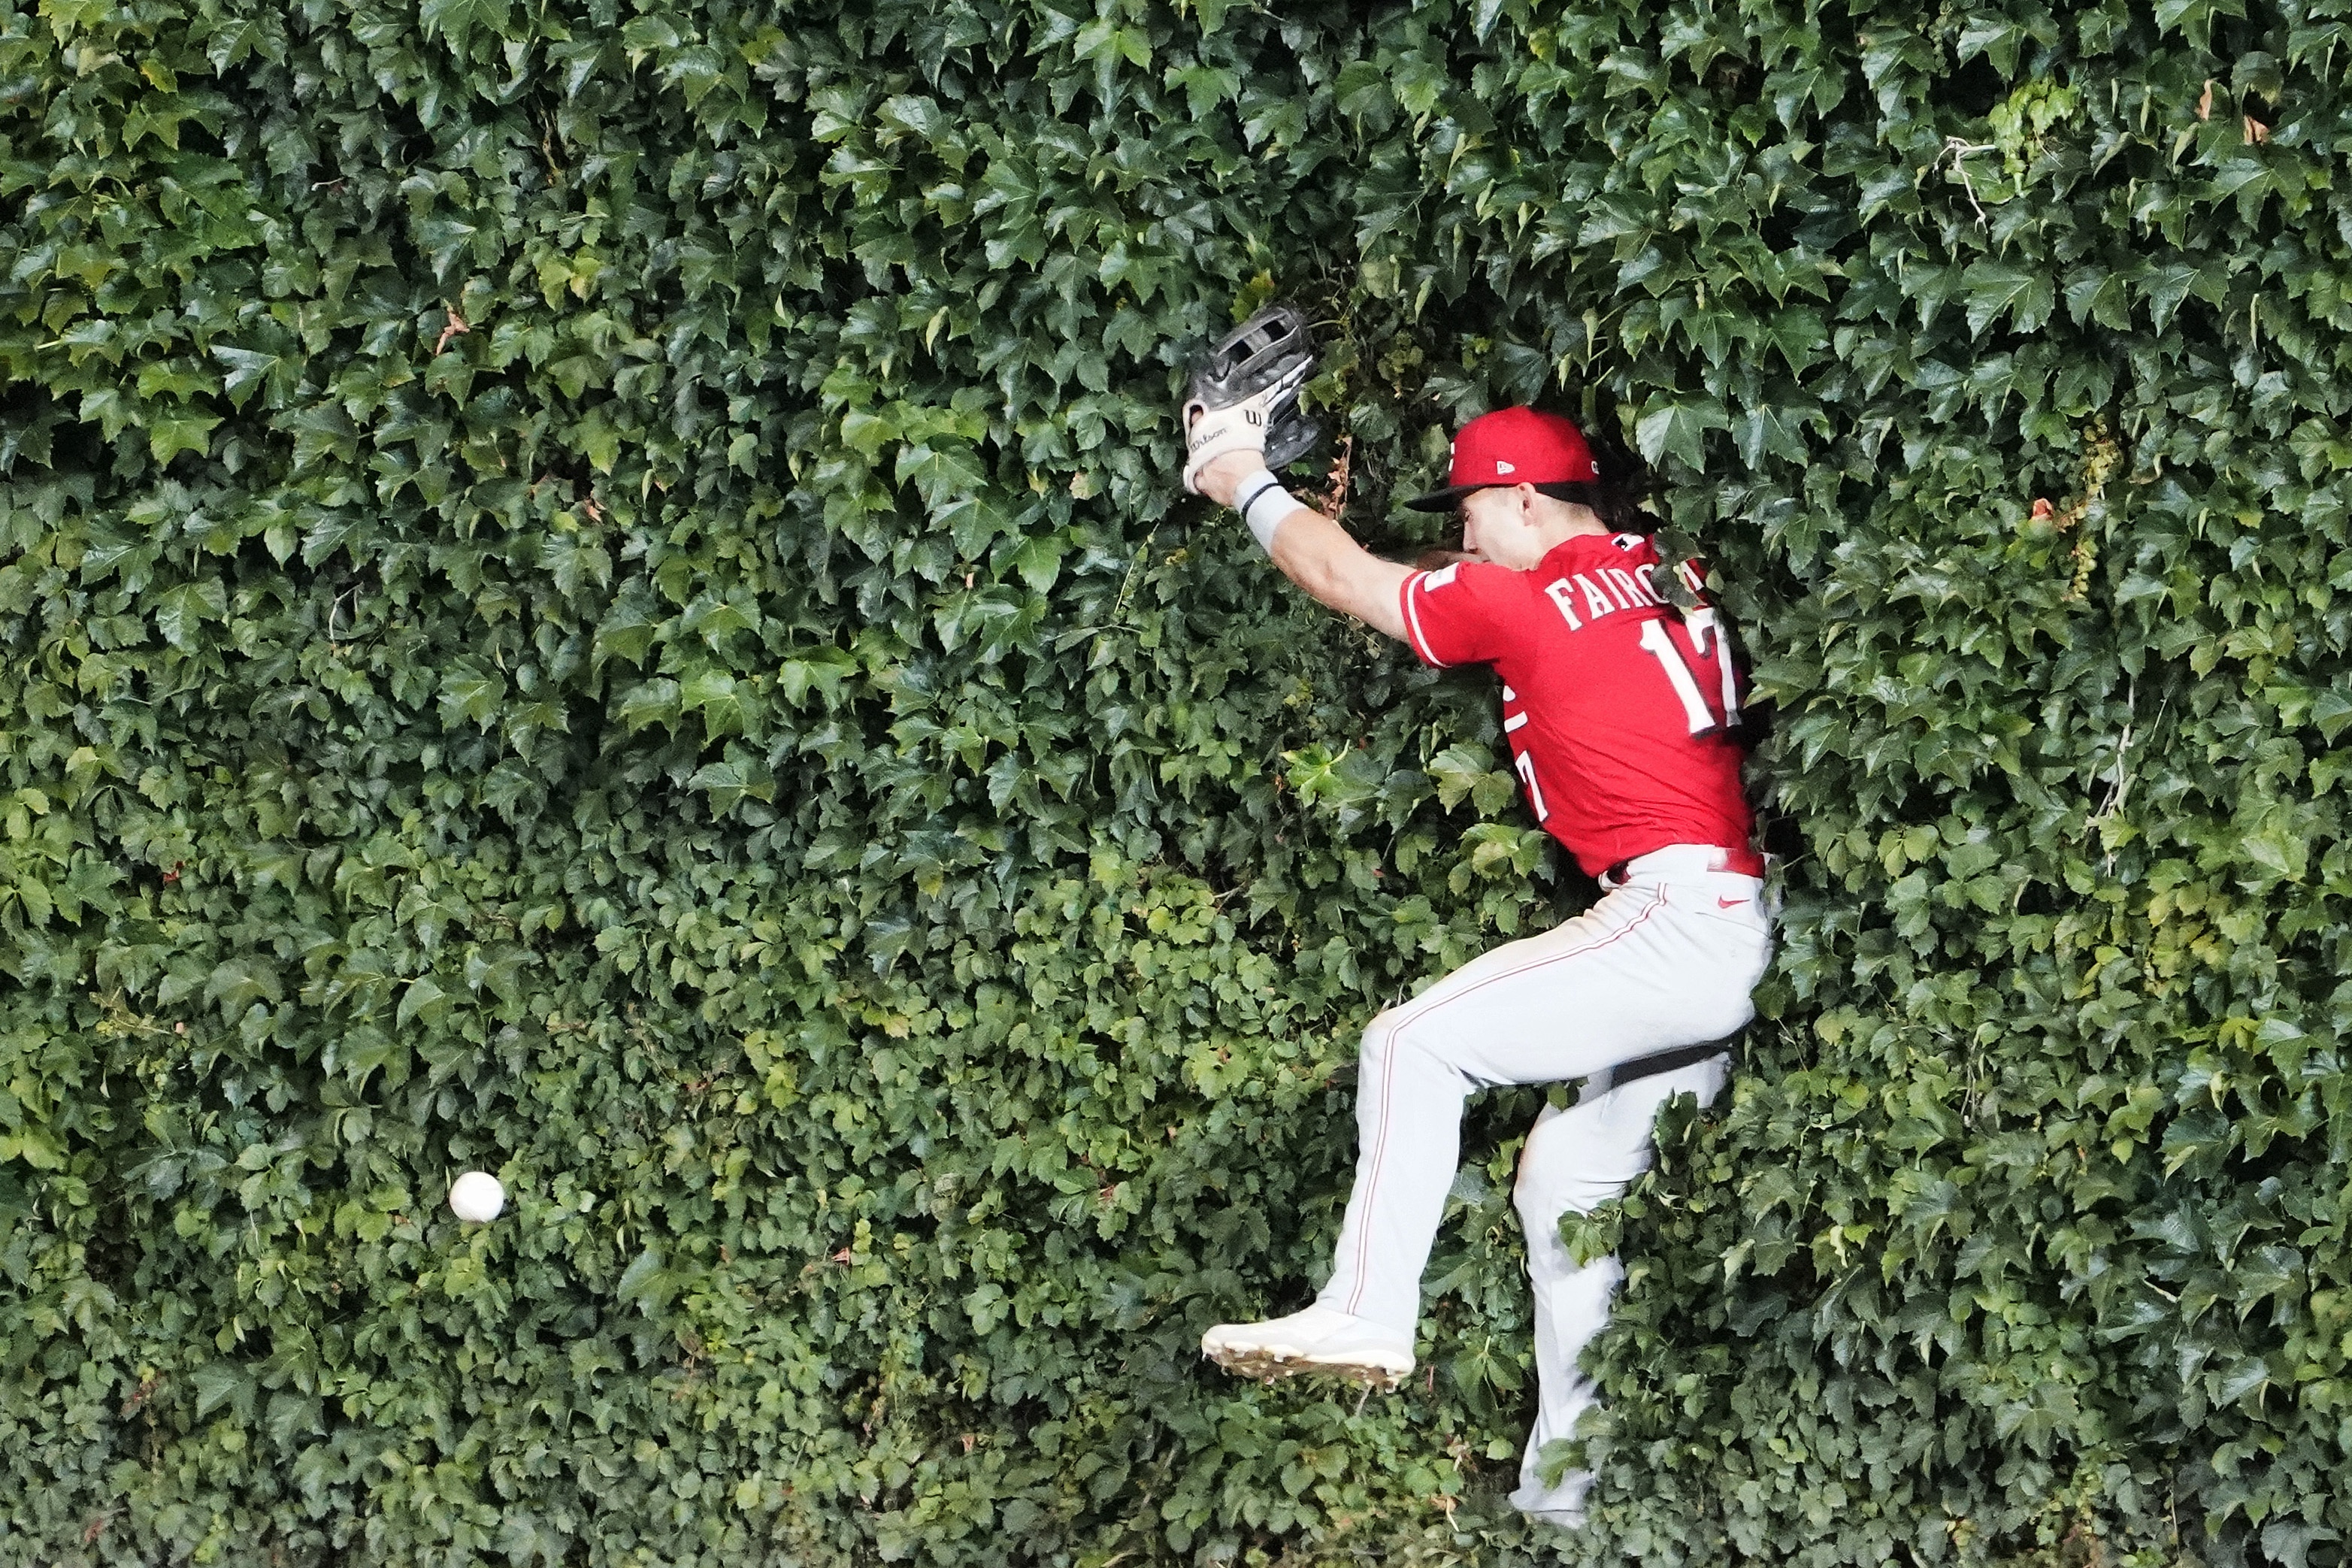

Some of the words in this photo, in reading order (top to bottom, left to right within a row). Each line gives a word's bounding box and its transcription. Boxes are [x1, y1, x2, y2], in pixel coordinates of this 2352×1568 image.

[1190, 428, 1227, 451] Wilson
[1545, 559, 1705, 631] FAIRC
[1639, 607, 1742, 734] 17
[1515, 750, 1548, 822] 7
